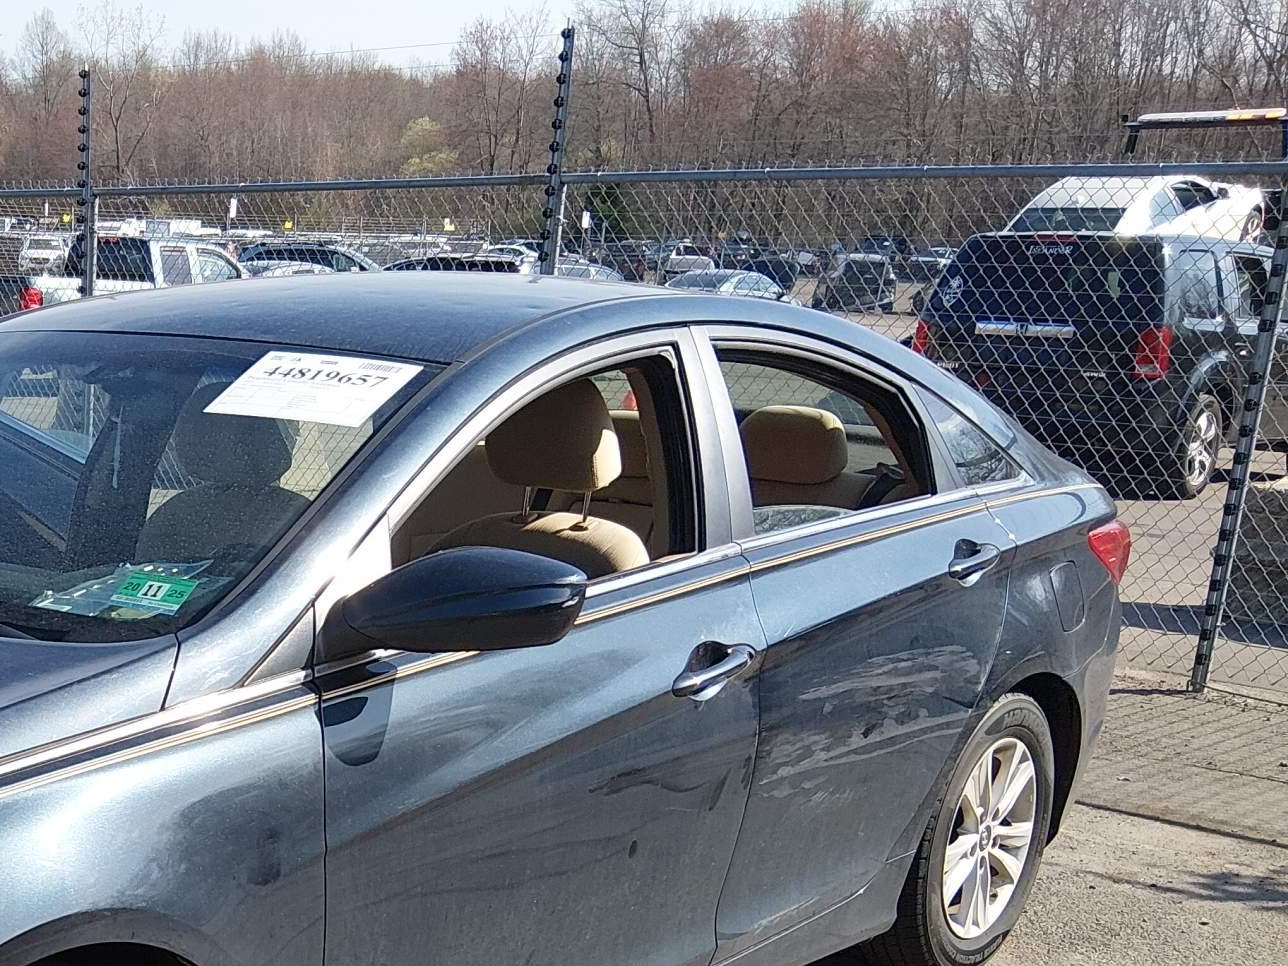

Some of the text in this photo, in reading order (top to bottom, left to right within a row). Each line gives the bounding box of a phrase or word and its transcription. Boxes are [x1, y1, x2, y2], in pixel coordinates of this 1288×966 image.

[263, 365, 389, 388] 44819657
[123, 581, 186, 599] 20 11 25
